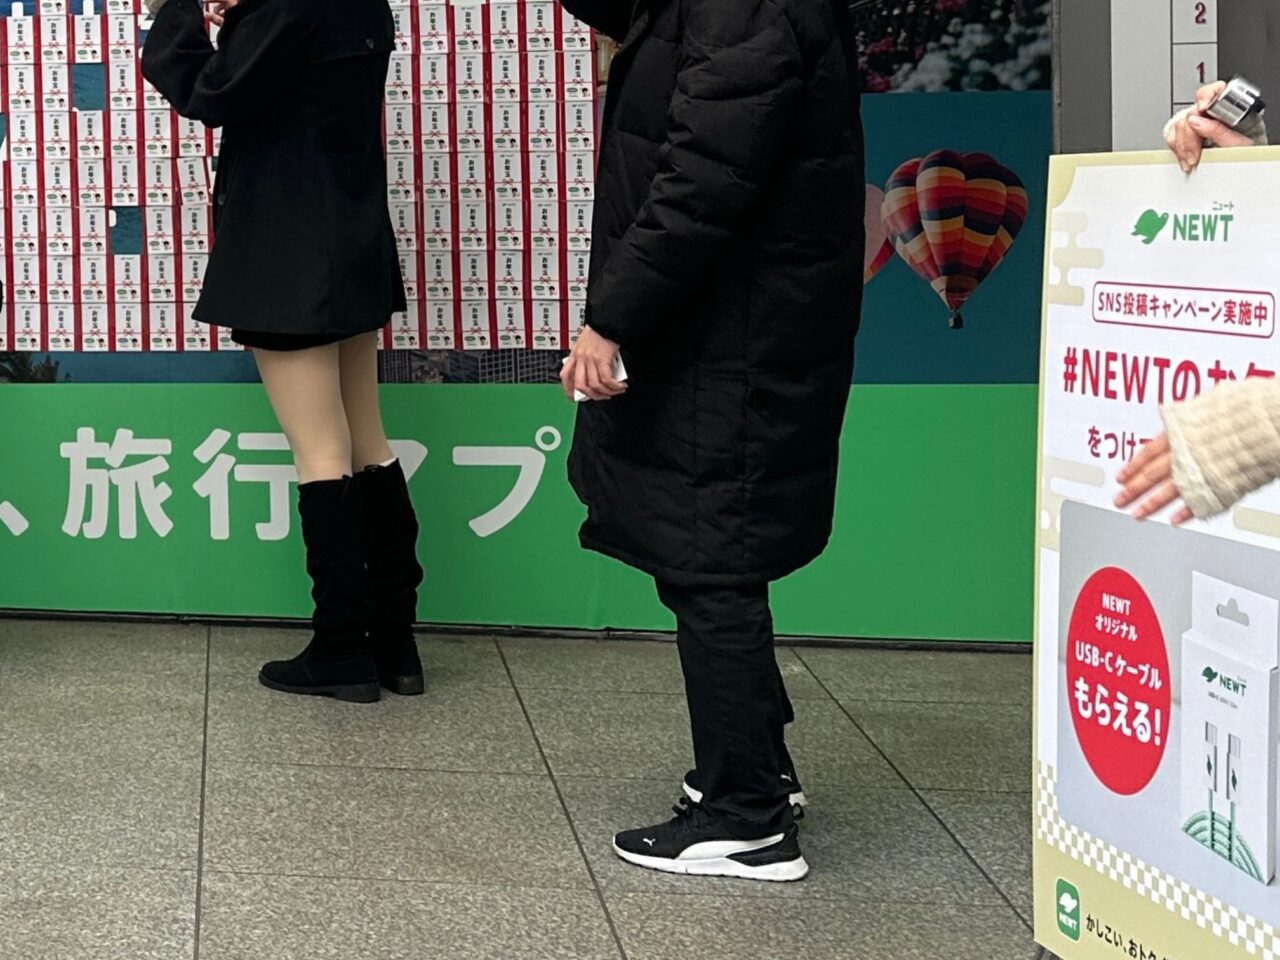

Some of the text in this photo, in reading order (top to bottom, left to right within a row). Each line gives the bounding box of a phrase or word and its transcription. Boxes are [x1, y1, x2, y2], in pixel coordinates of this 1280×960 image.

[1194, 2, 1207, 25] 2
[1195, 62, 1205, 84] 1
[1172, 214, 1235, 243] NEWT
[1097, 292, 1269, 328] SNS投稿キャンペーン実施中
[1101, 592, 1132, 617] NEWT
[1094, 614, 1138, 642] オリジナル
[1219, 674, 1247, 697] NEWT
